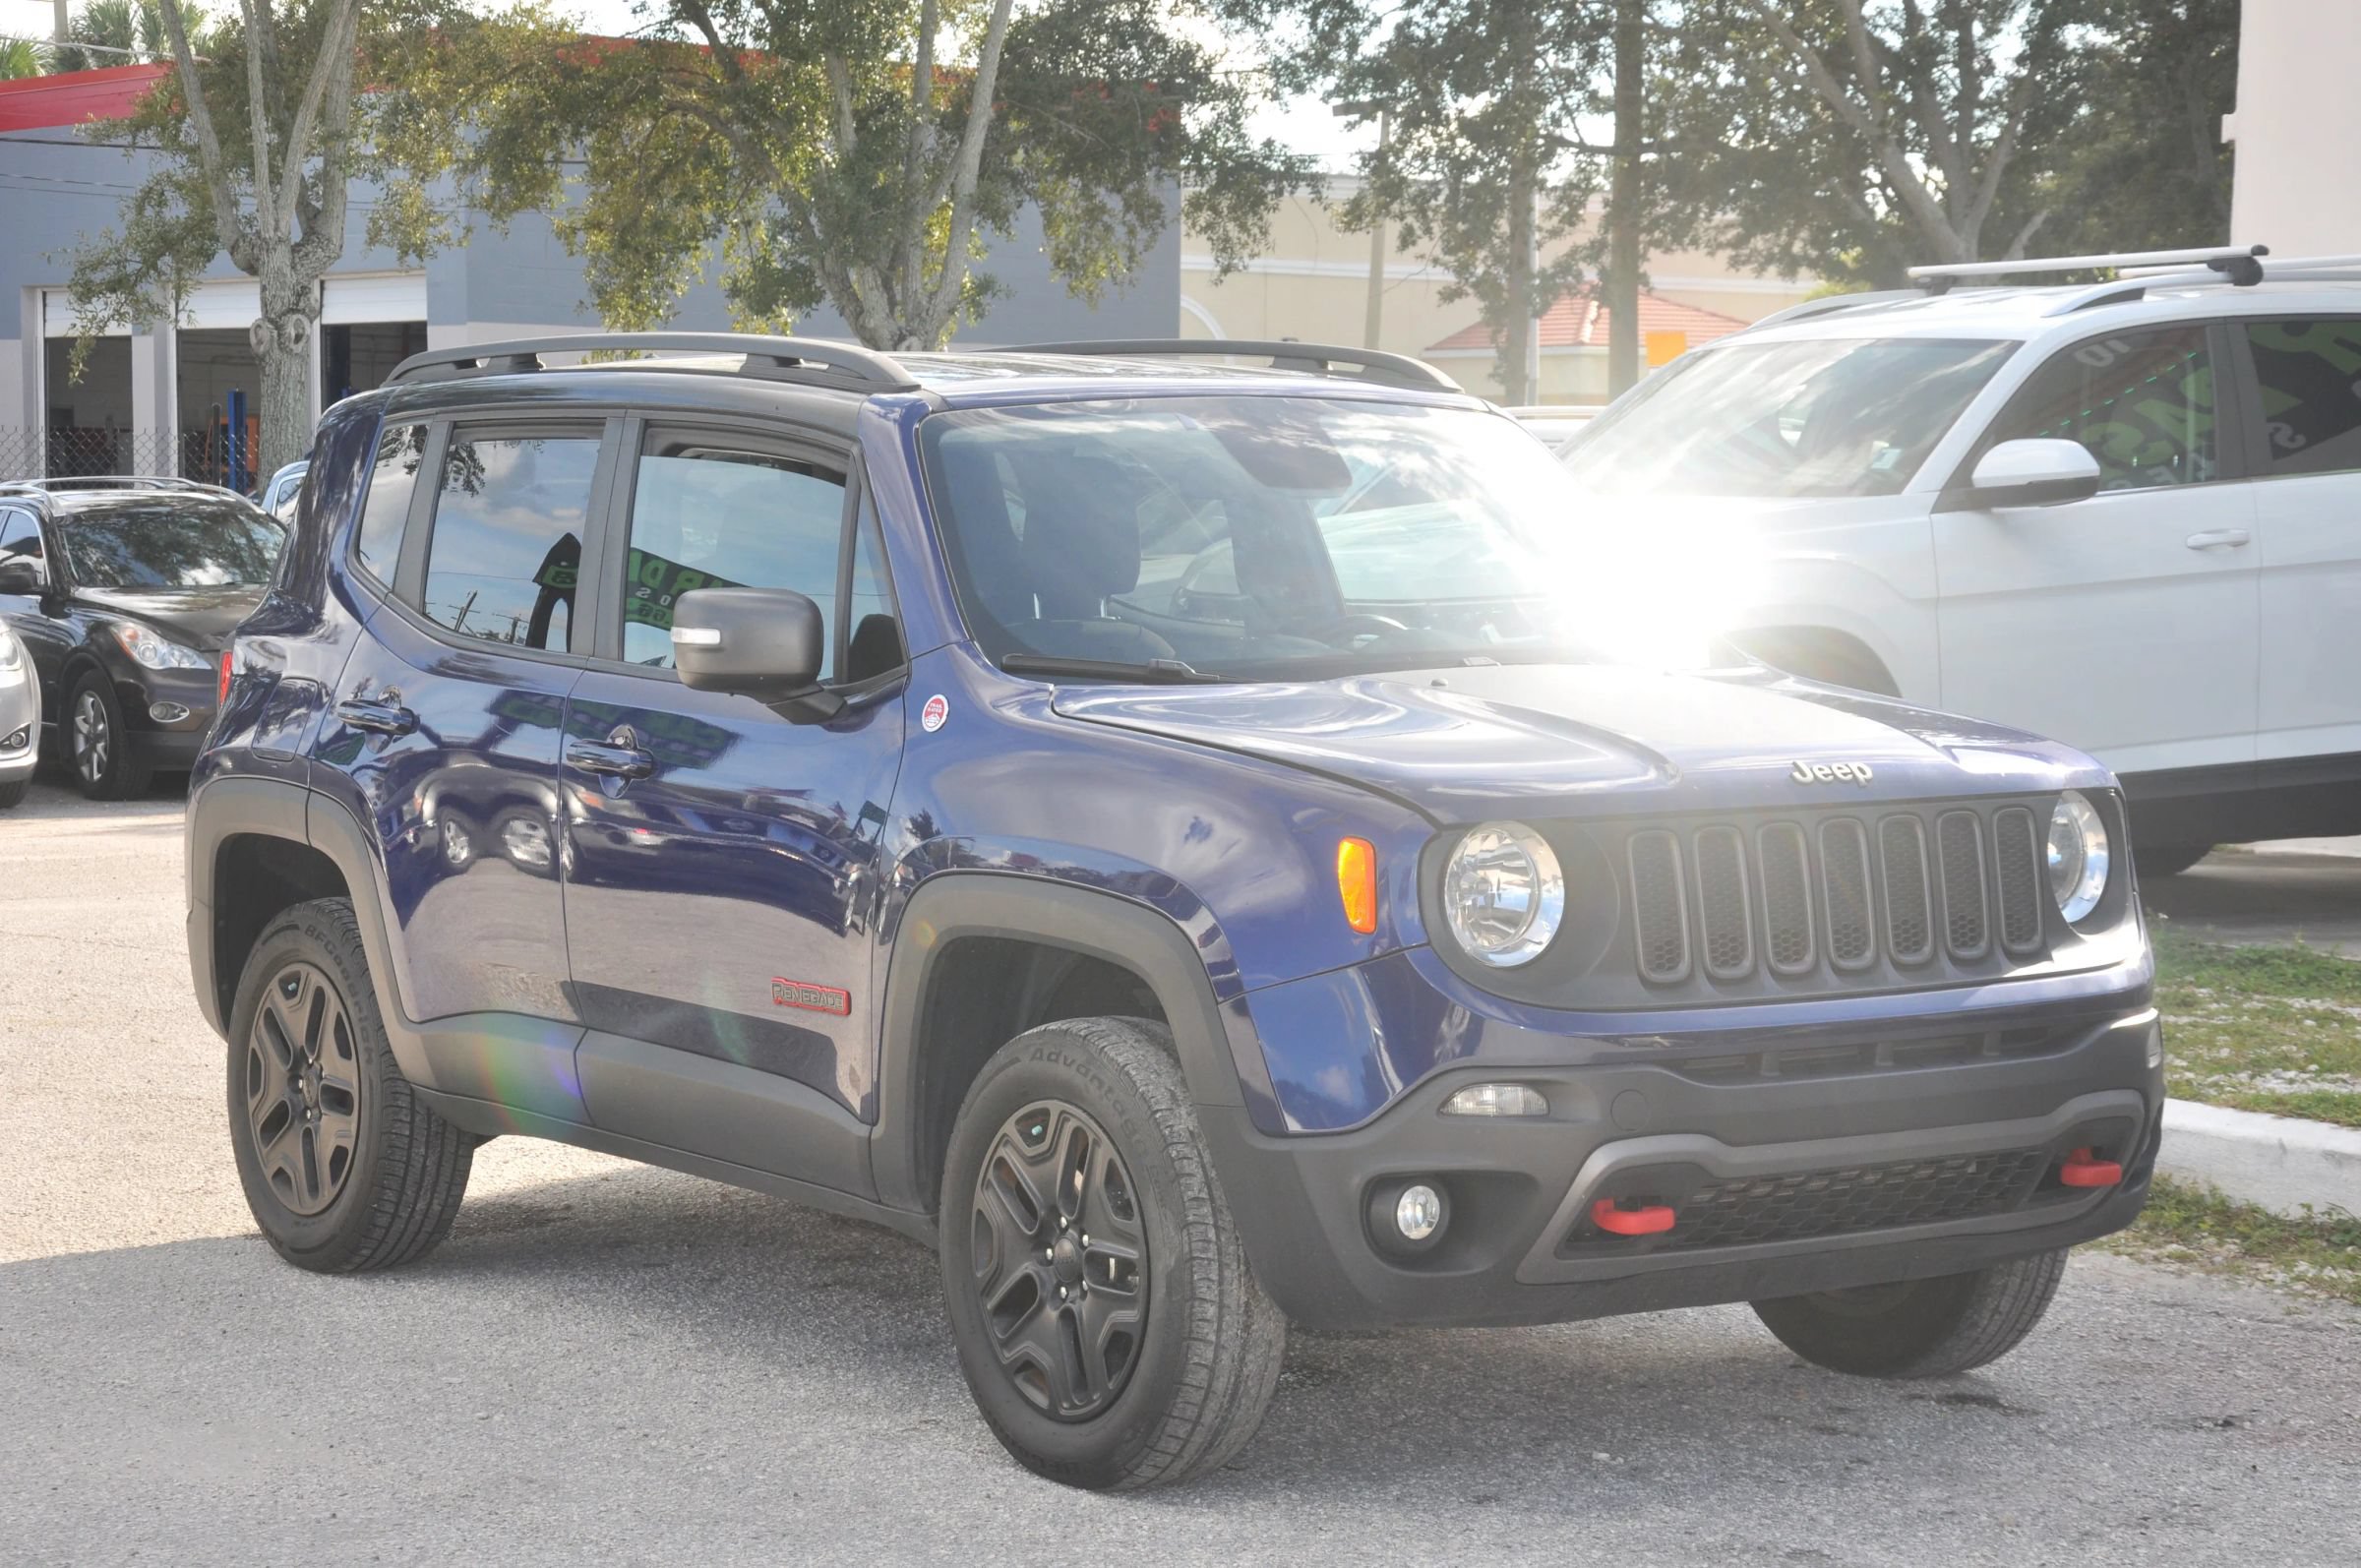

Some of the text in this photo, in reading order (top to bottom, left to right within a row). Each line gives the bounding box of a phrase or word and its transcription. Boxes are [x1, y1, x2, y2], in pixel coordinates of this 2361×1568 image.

[1791, 760, 1873, 788] Jeep
[304, 923, 374, 1064] BFGoodrich
[772, 983, 843, 1011] RENEGADE
